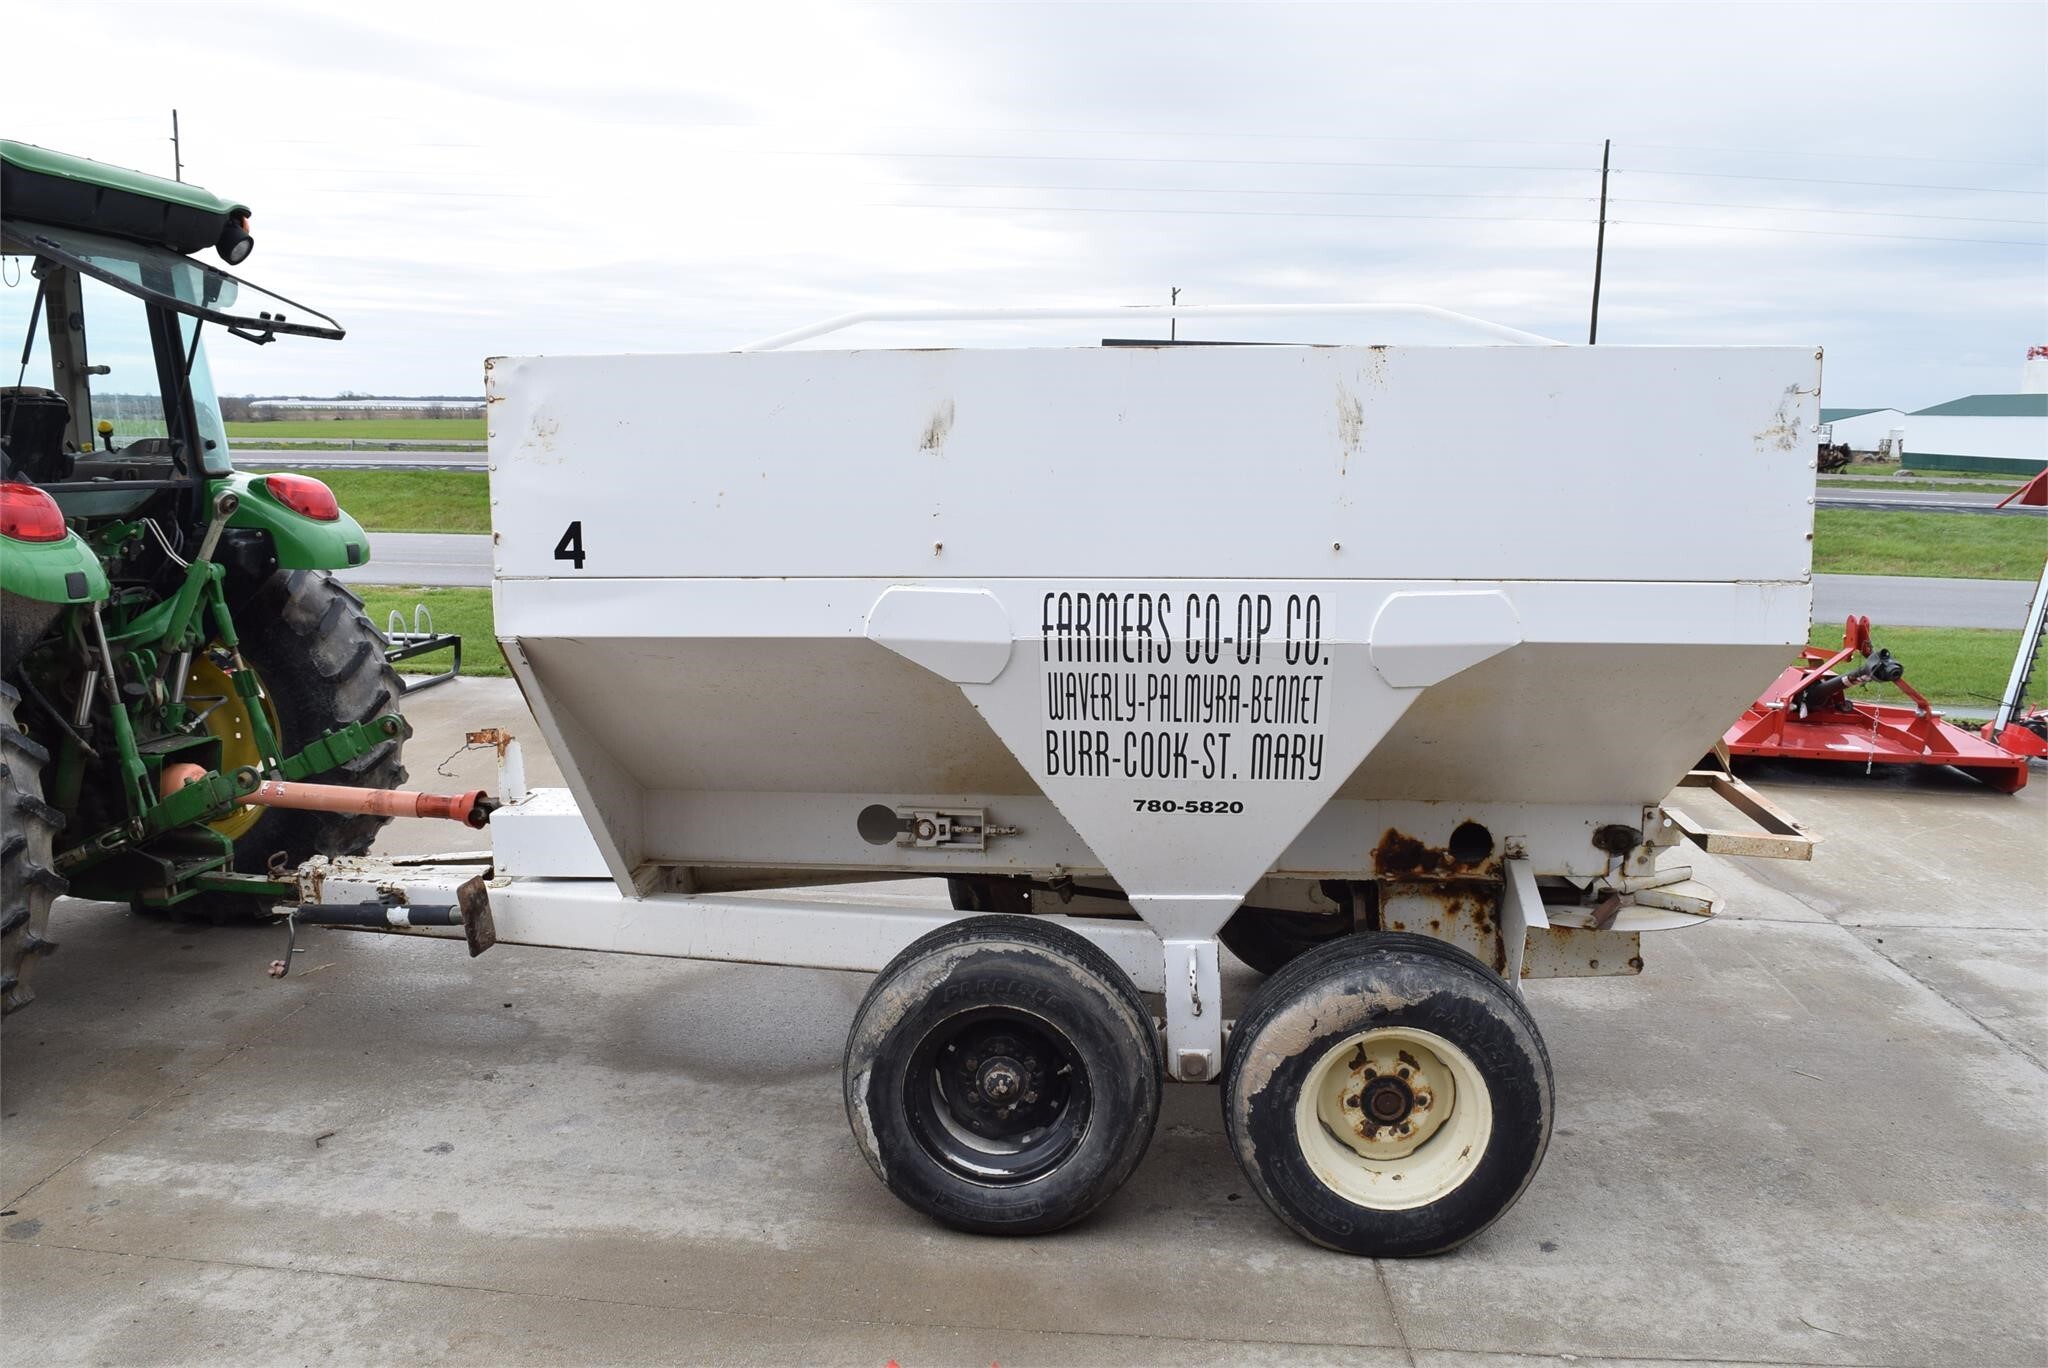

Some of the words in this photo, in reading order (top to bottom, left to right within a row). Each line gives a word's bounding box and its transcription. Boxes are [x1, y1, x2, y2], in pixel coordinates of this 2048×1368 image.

[554, 521, 585, 570] 4
[1042, 592, 1171, 664] FARMERS
[1186, 593, 1272, 665] CO-OP
[1285, 594, 1329, 666] CO.
[1047, 672, 1323, 724] WAVERLY-PALMYRA-BENNET
[1046, 730, 1238, 780] BURR-COOK-ST.
[1250, 733, 1324, 781] MARY
[1133, 799, 1244, 814] 780-5820
